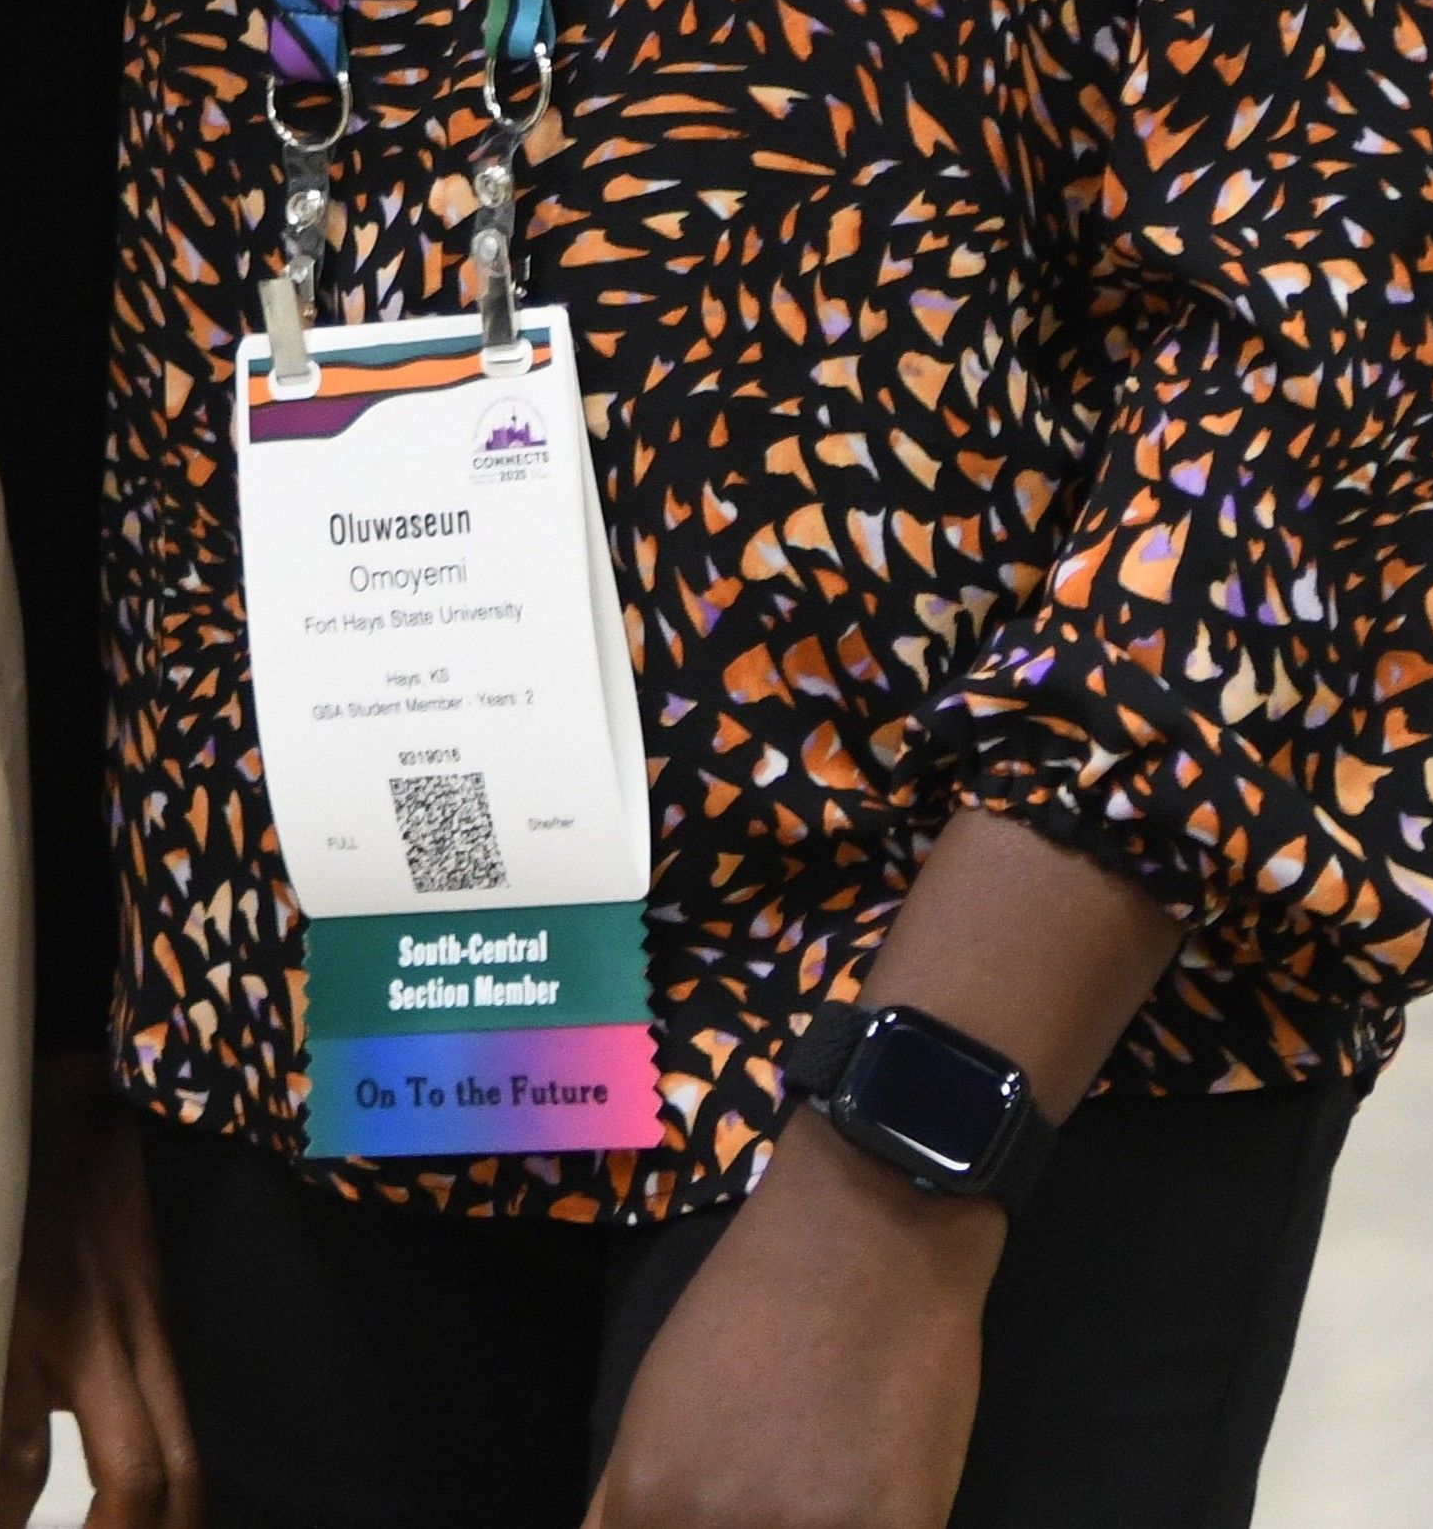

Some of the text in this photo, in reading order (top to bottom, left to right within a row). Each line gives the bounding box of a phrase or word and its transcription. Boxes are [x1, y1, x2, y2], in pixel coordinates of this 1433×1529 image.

[472, 452, 550, 470] CONNECTS
[329, 509, 471, 546] Oluwaseun
[349, 557, 468, 596] Omoyemi
[304, 600, 524, 636] Fort Hays State University
[347, 700, 401, 717] Student
[405, 696, 463, 713] Member
[398, 930, 548, 968] South-Central
[388, 974, 560, 1011] Section Member
[356, 1074, 609, 1109] On To the Future
